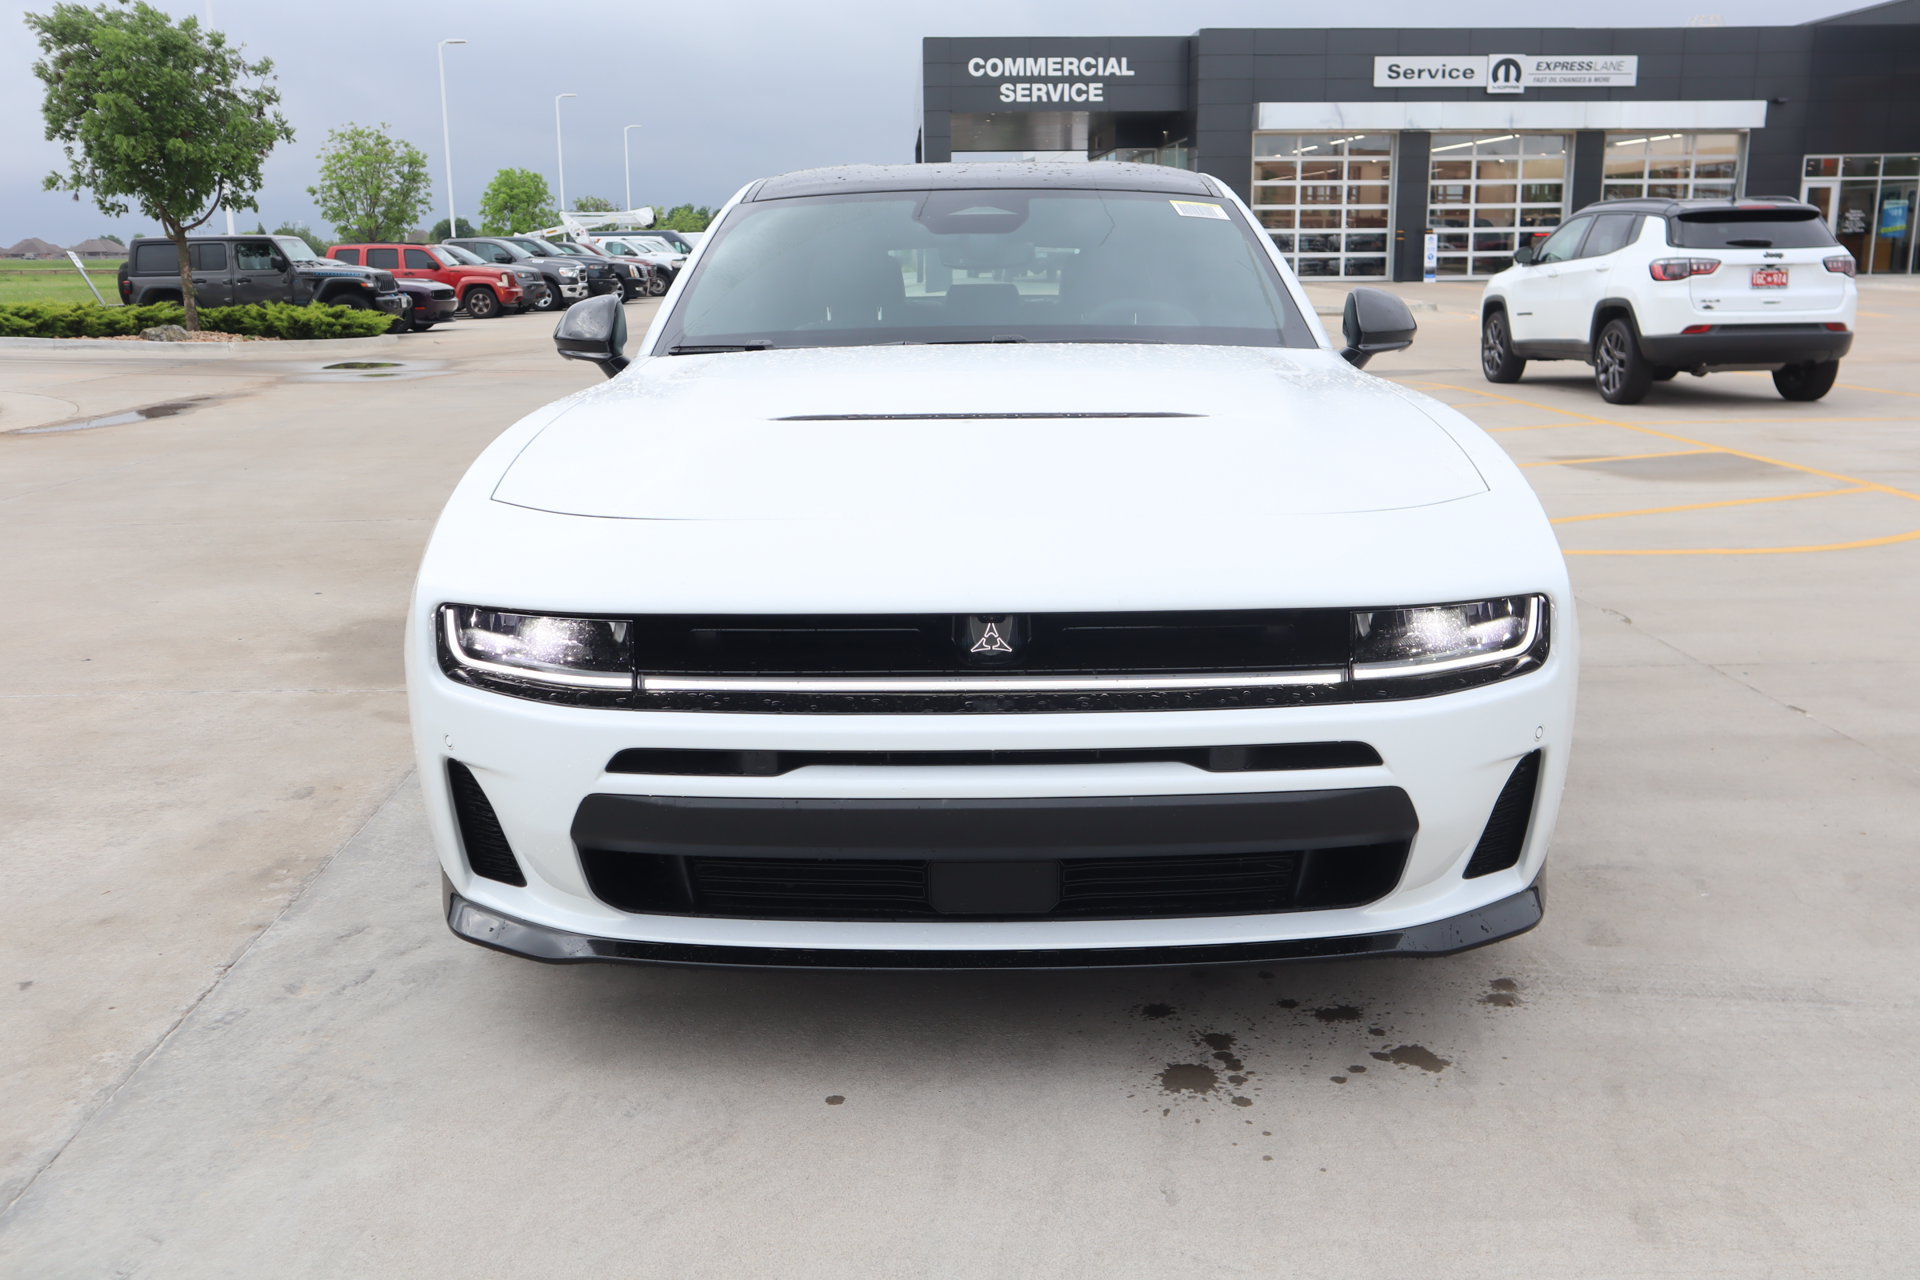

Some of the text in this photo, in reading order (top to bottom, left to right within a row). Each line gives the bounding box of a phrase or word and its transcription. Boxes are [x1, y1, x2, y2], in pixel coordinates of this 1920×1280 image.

[967, 57, 1136, 78] COMMERCIAL
[1387, 63, 1475, 80] Service
[999, 82, 1104, 103] SERVICE
